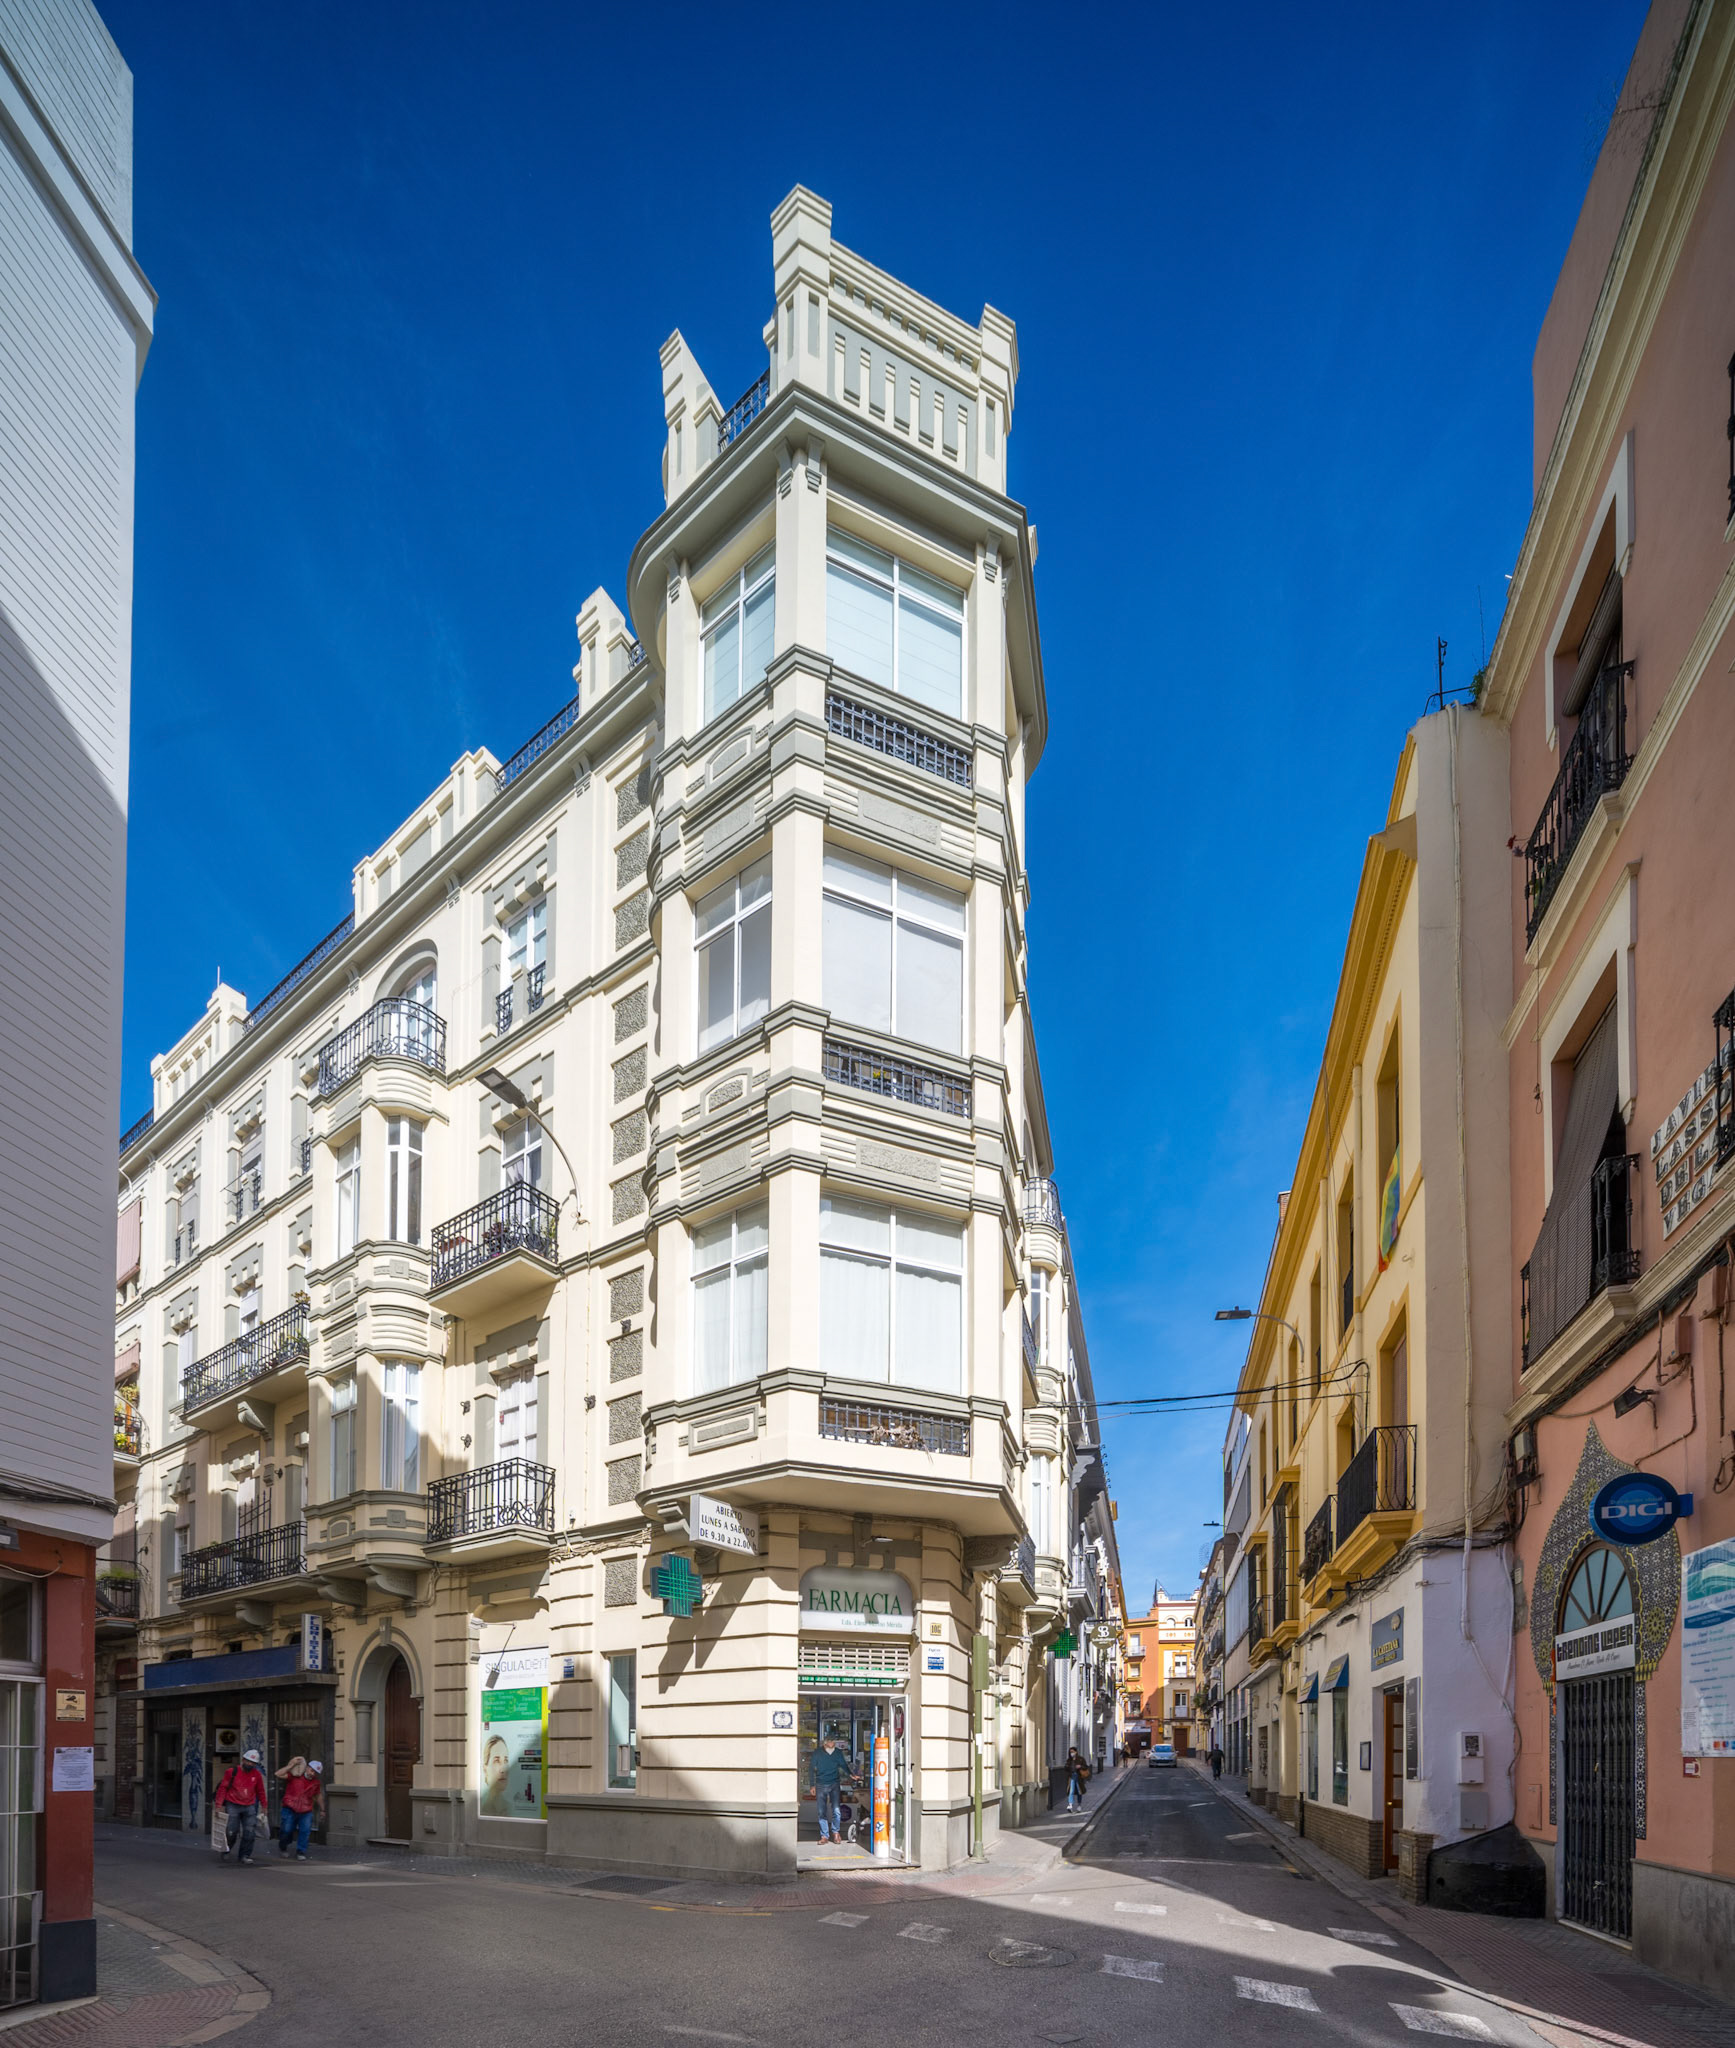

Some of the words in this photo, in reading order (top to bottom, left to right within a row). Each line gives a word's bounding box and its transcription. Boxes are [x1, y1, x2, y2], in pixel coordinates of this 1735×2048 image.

[1661, 1159, 1689, 1208] DE
[716, 1505, 743, 1520] ABIERTO
[1601, 1501, 1673, 1519] DIGI
[701, 1514, 722, 1527] LUNES
[724, 1521, 728, 1530] A
[730, 1523, 756, 1537] SABADO
[700, 1527, 708, 1538] DE
[711, 1531, 725, 1542] 9.30
[733, 1537, 751, 1549] 22.00
[809, 1588, 902, 1616] FARMACIA
